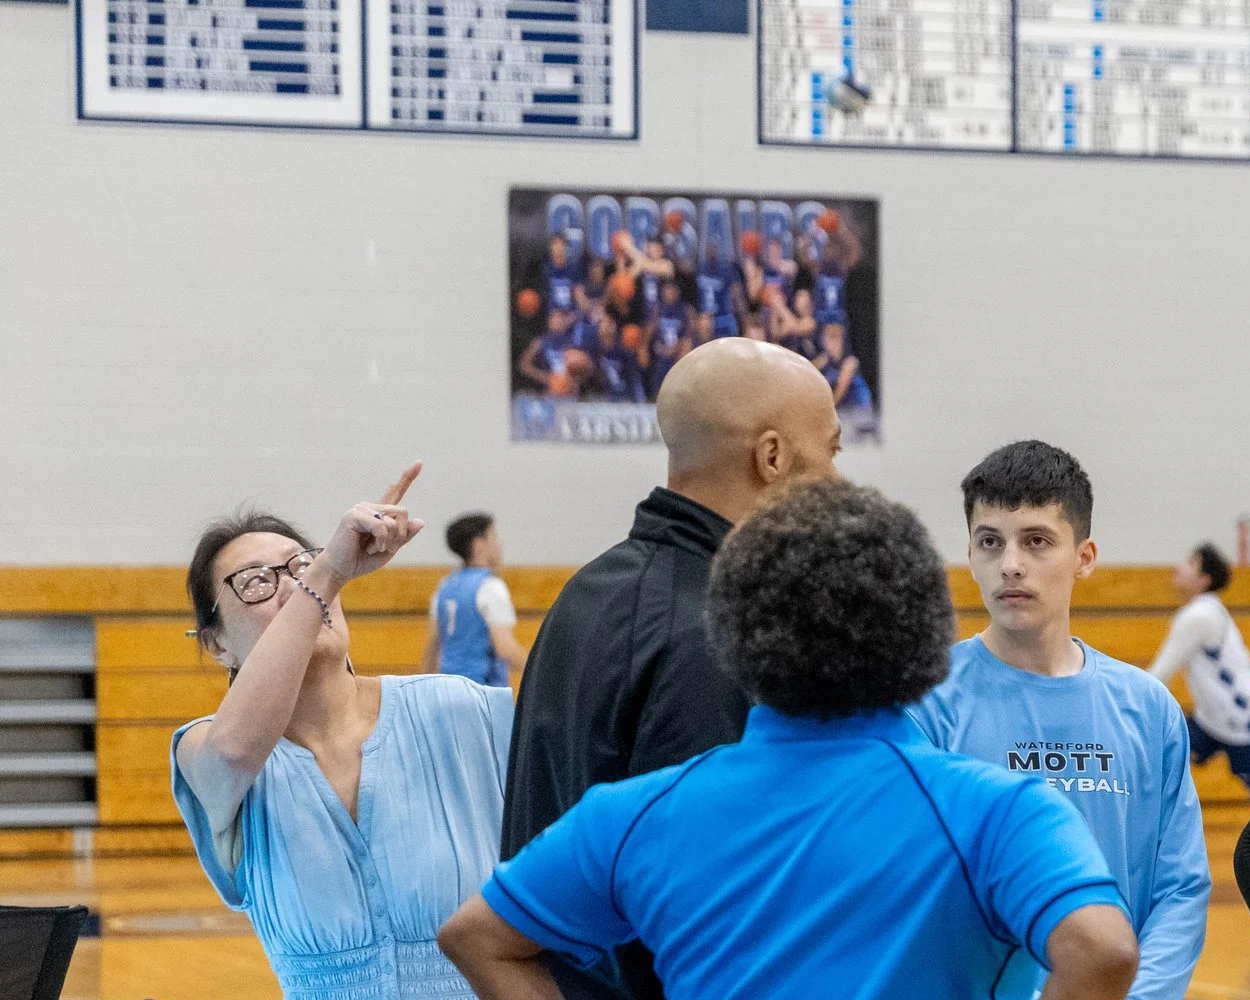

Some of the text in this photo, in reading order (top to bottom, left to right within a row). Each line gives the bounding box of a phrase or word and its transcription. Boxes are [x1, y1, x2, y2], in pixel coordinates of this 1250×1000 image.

[1015, 741, 1104, 751] WATERFORD
[1007, 751, 1115, 773] MOTT
[1046, 777, 1131, 796] EYBALL
